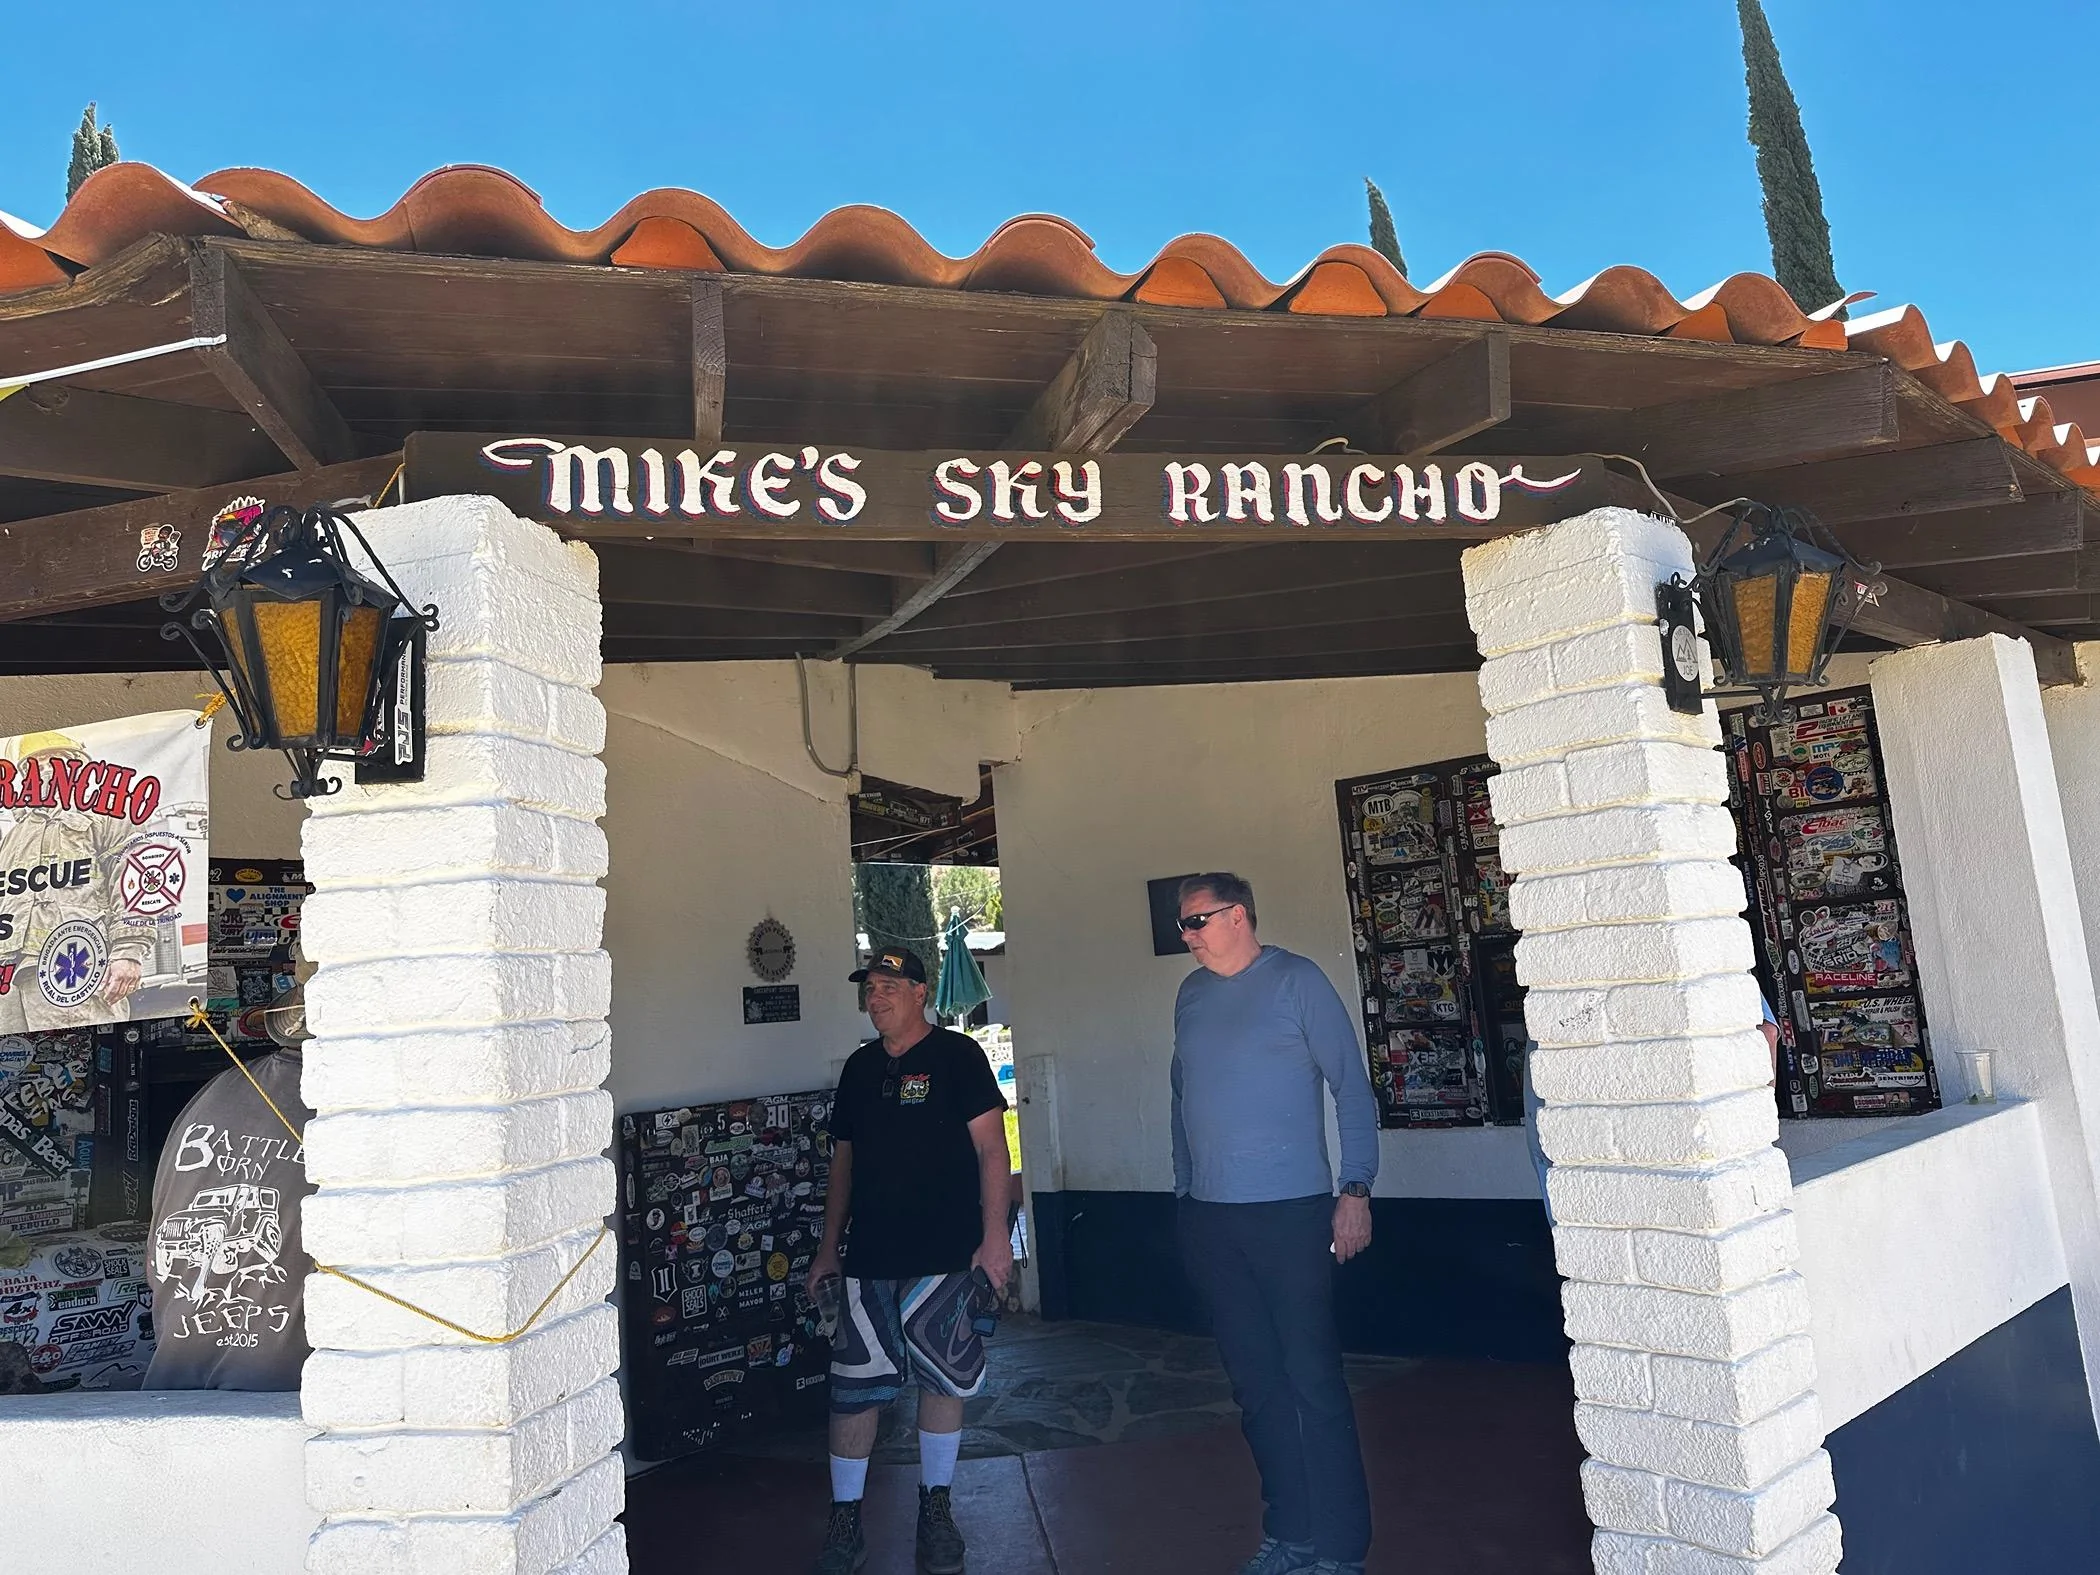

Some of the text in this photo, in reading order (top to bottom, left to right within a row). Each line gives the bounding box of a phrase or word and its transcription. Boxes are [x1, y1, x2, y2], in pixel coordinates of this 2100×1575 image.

[542, 442, 1505, 528] MIKE'S SKY RANCHO
[1367, 799, 1391, 814] MTB
[144, 831, 175, 841] DISPUESTOS
[0, 857, 92, 897] SCUE
[42, 925, 104, 966] BRIGADA ANTE EMERGENCIAS
[1822, 950, 1858, 967] GRID
[1815, 973, 1877, 981] RACELINE
[42, 971, 101, 1003] REAL DEL CASTILLO
[1436, 1002, 1455, 1013] KTG
[1883, 996, 1914, 1007] WHEEL
[32, 1134, 73, 1172] Beer
[709, 1153, 729, 1166] BAJA
[11, 1218, 60, 1231] REBUILD
[104, 1259, 127, 1267] SHOCK
[105, 1265, 128, 1275] SEALS
[173, 1303, 290, 1339] JEEPS
[51, 1324, 128, 1343] OFF ROAD
